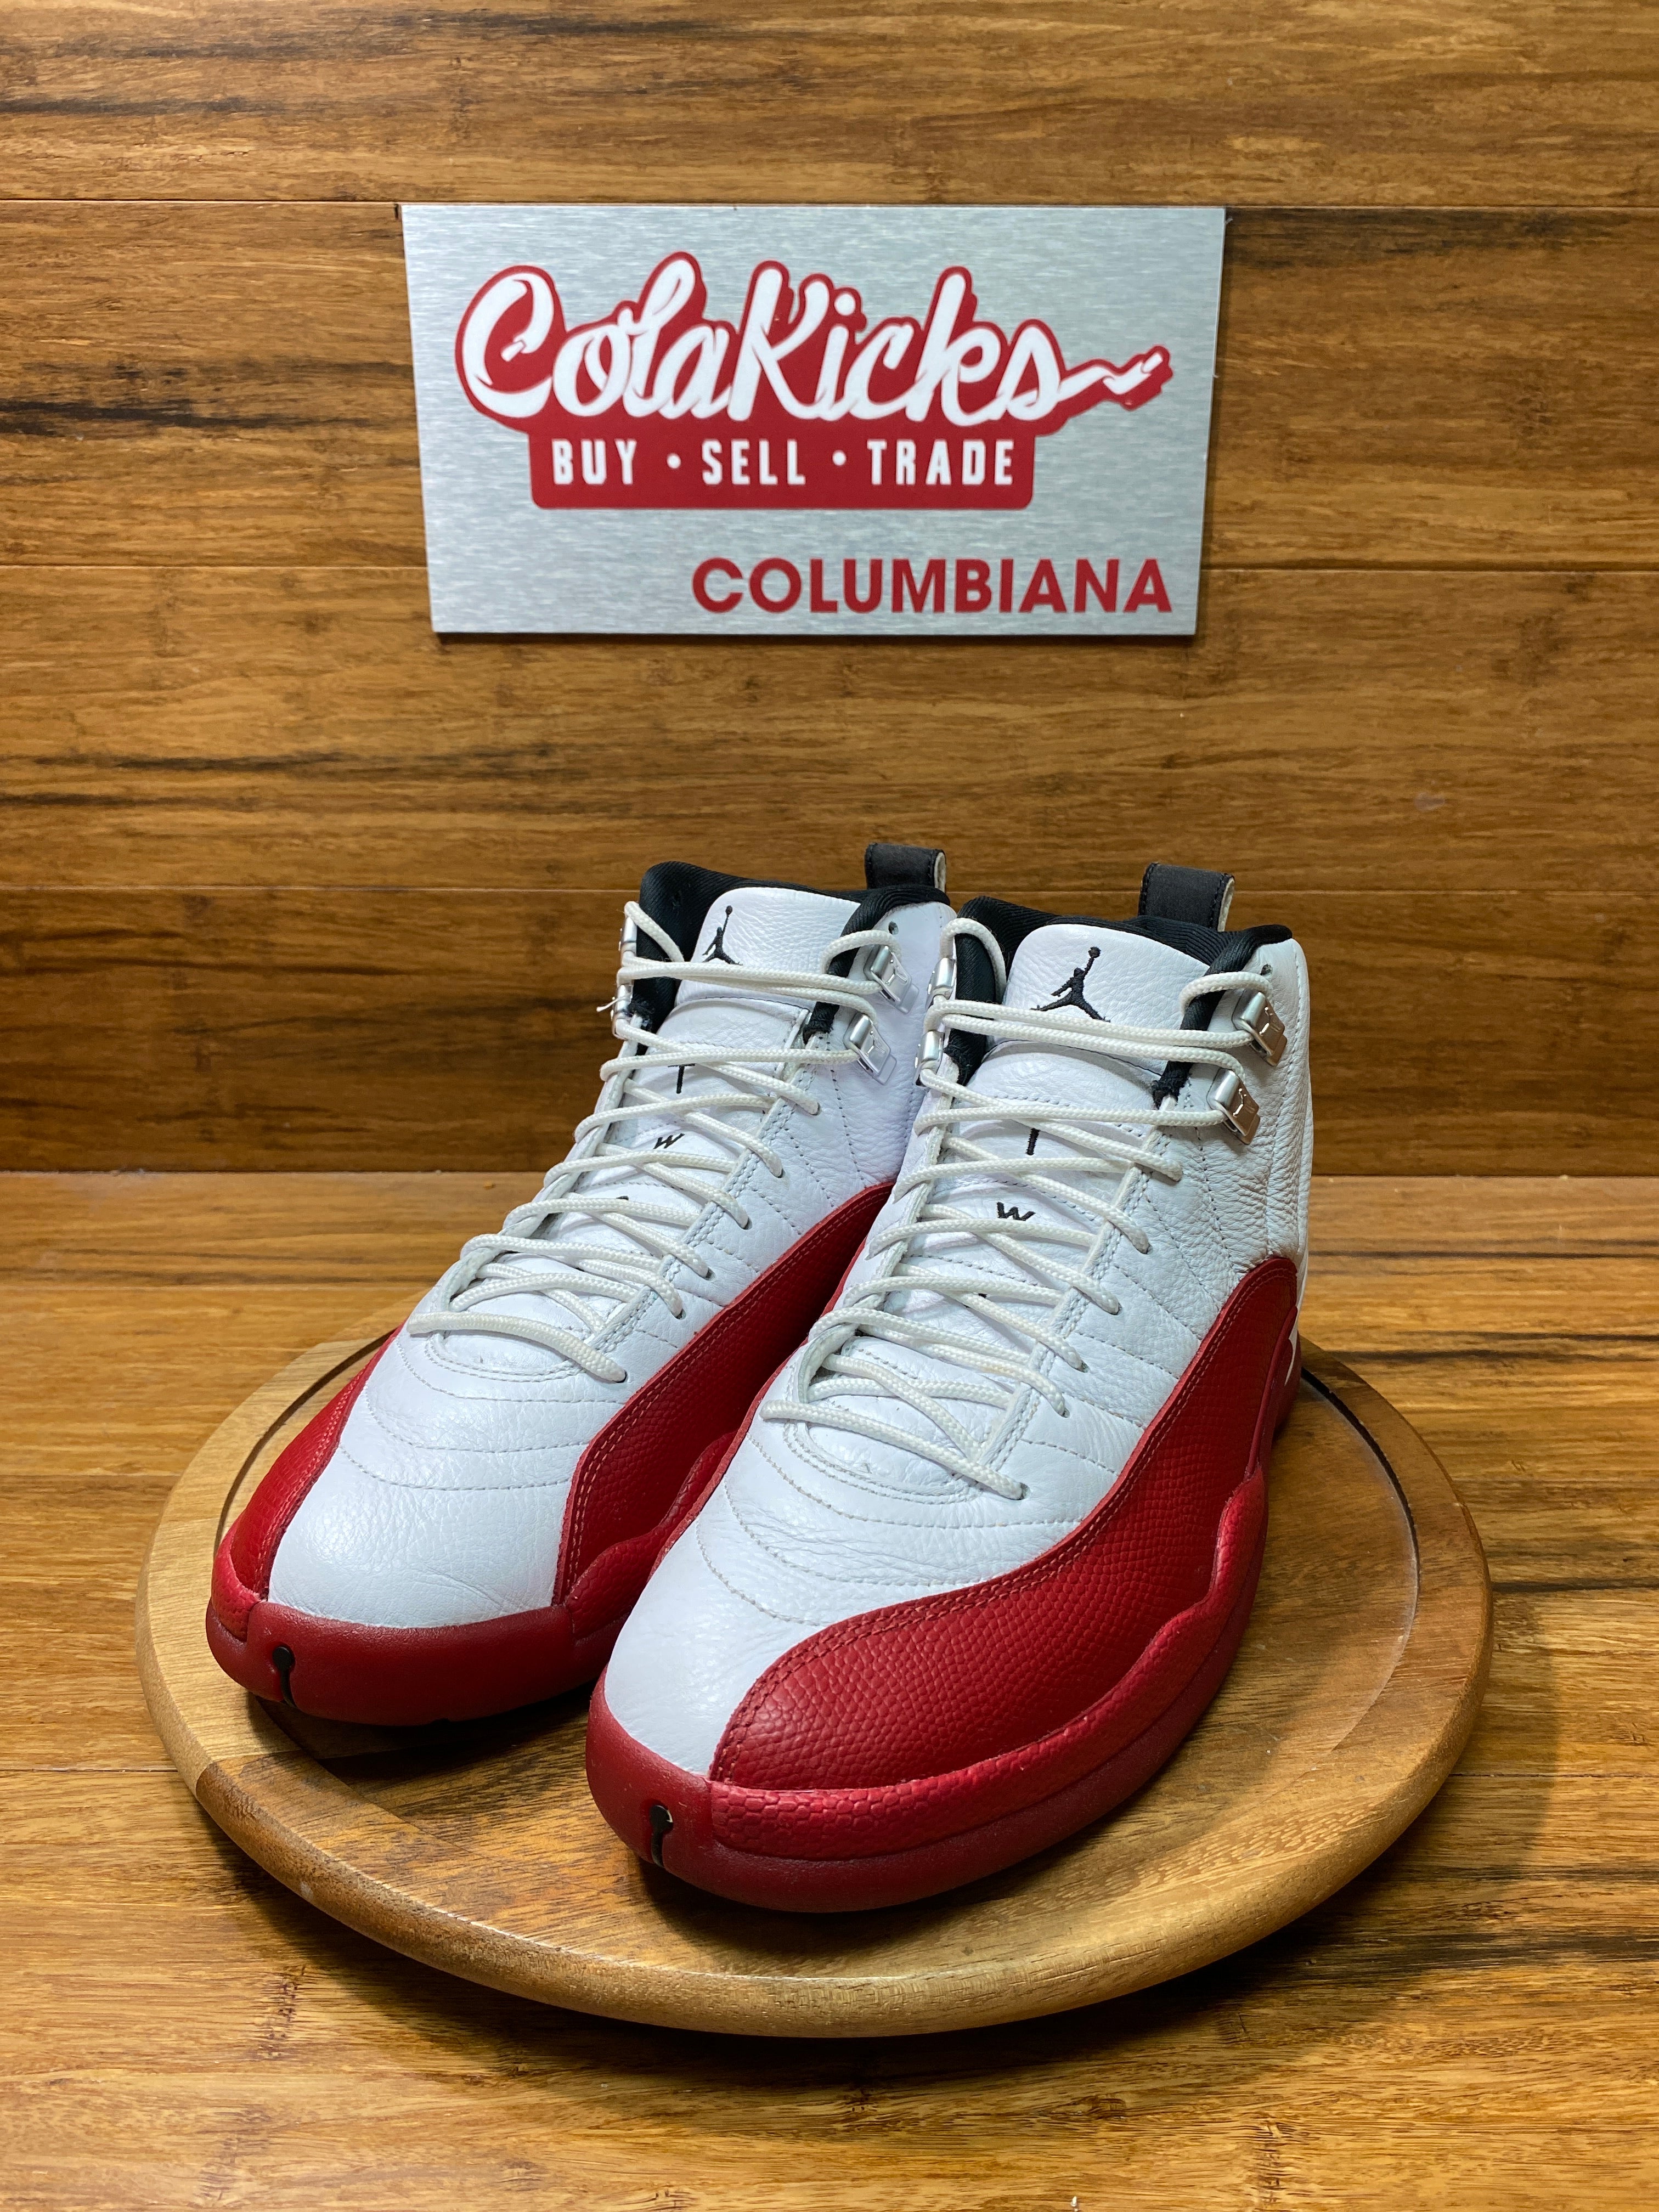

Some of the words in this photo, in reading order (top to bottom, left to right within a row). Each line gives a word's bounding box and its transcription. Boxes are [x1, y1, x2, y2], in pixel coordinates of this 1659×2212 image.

[461, 257, 1164, 427] ColaKicks
[551, 438, 638, 486] BUY
[701, 439, 807, 486] SELL
[866, 439, 1015, 486] TRADE
[692, 557, 1172, 613] COLUMBIANA
